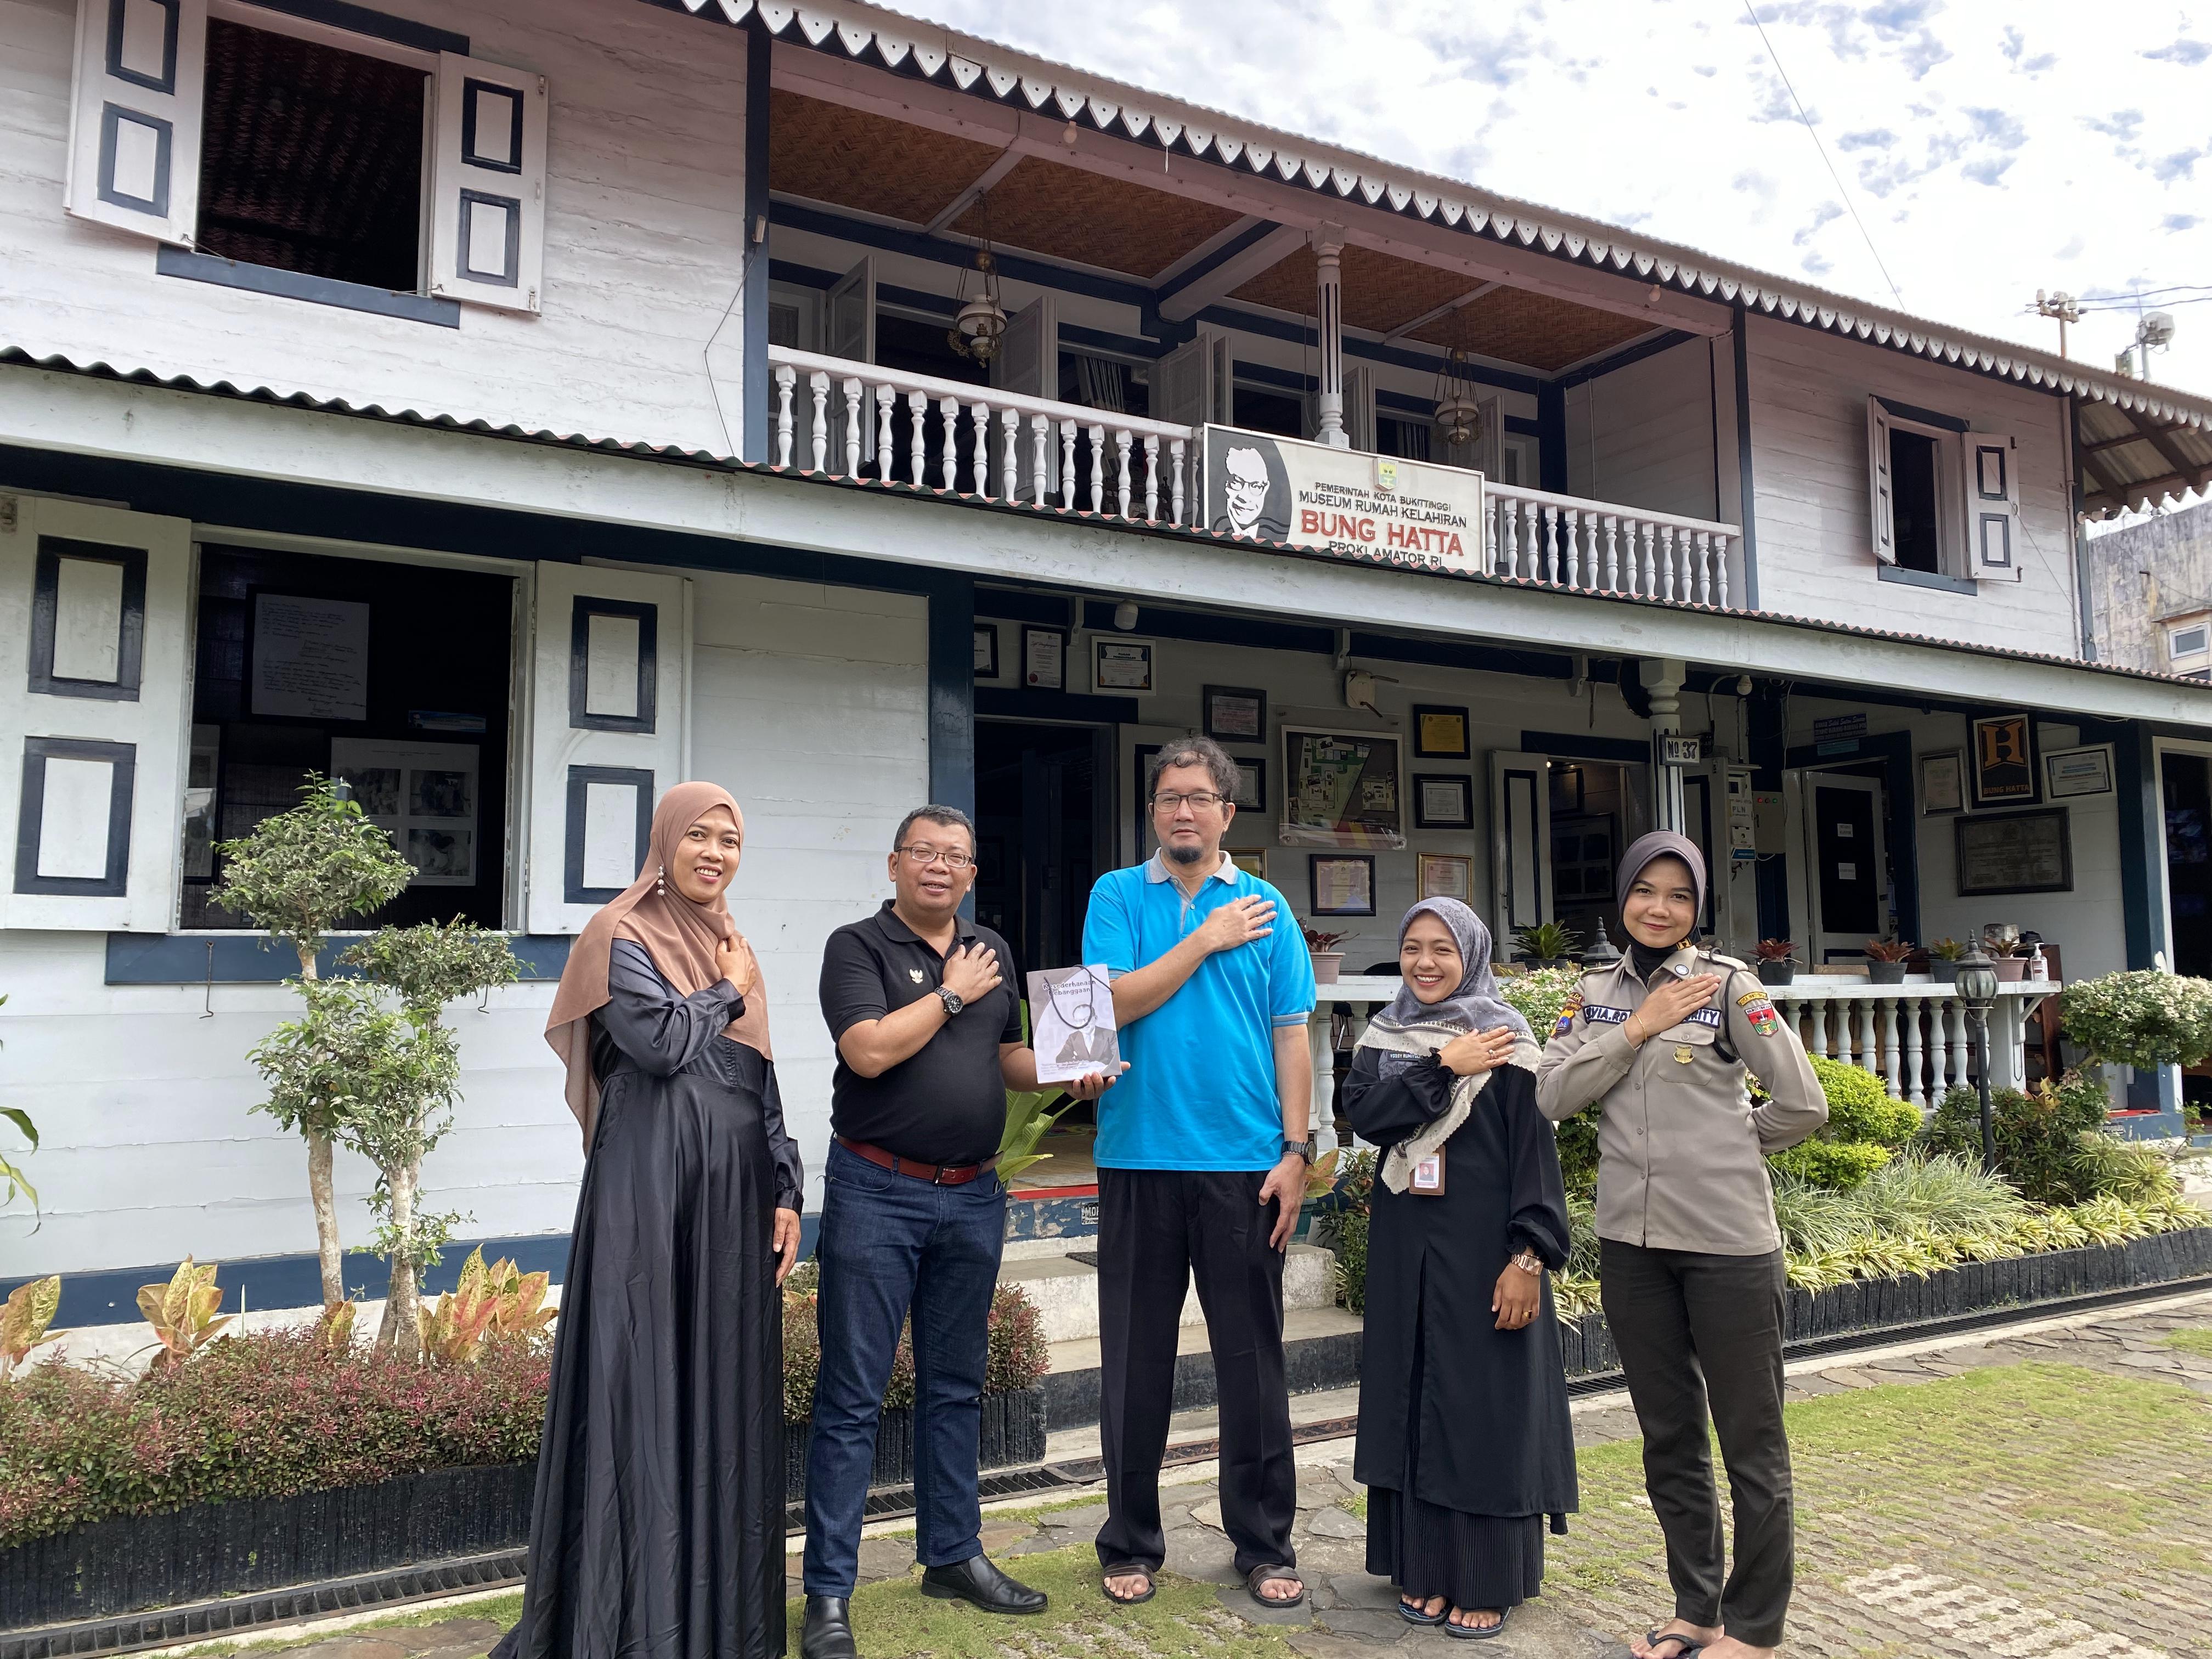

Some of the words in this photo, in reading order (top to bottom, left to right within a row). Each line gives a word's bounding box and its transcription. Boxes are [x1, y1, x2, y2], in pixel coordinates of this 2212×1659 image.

[1315, 482, 1369, 498] PEMERINTAH
[1374, 491, 1397, 503] KOTA
[1400, 495, 1451, 511] BUKITTINGGI
[1299, 490, 1351, 509] MUSEUM
[1355, 499, 1398, 517] RUMAH
[1401, 507, 1467, 528] KELAHIRAN
[1301, 509, 1376, 541] BUNG
[1387, 522, 1464, 556] HATTA
[1430, 555, 1442, 566] RI
[1682, 741, 1697, 759] 37
[1983, 786, 2004, 794] BUNG
[2005, 784, 2029, 792] HATTA
